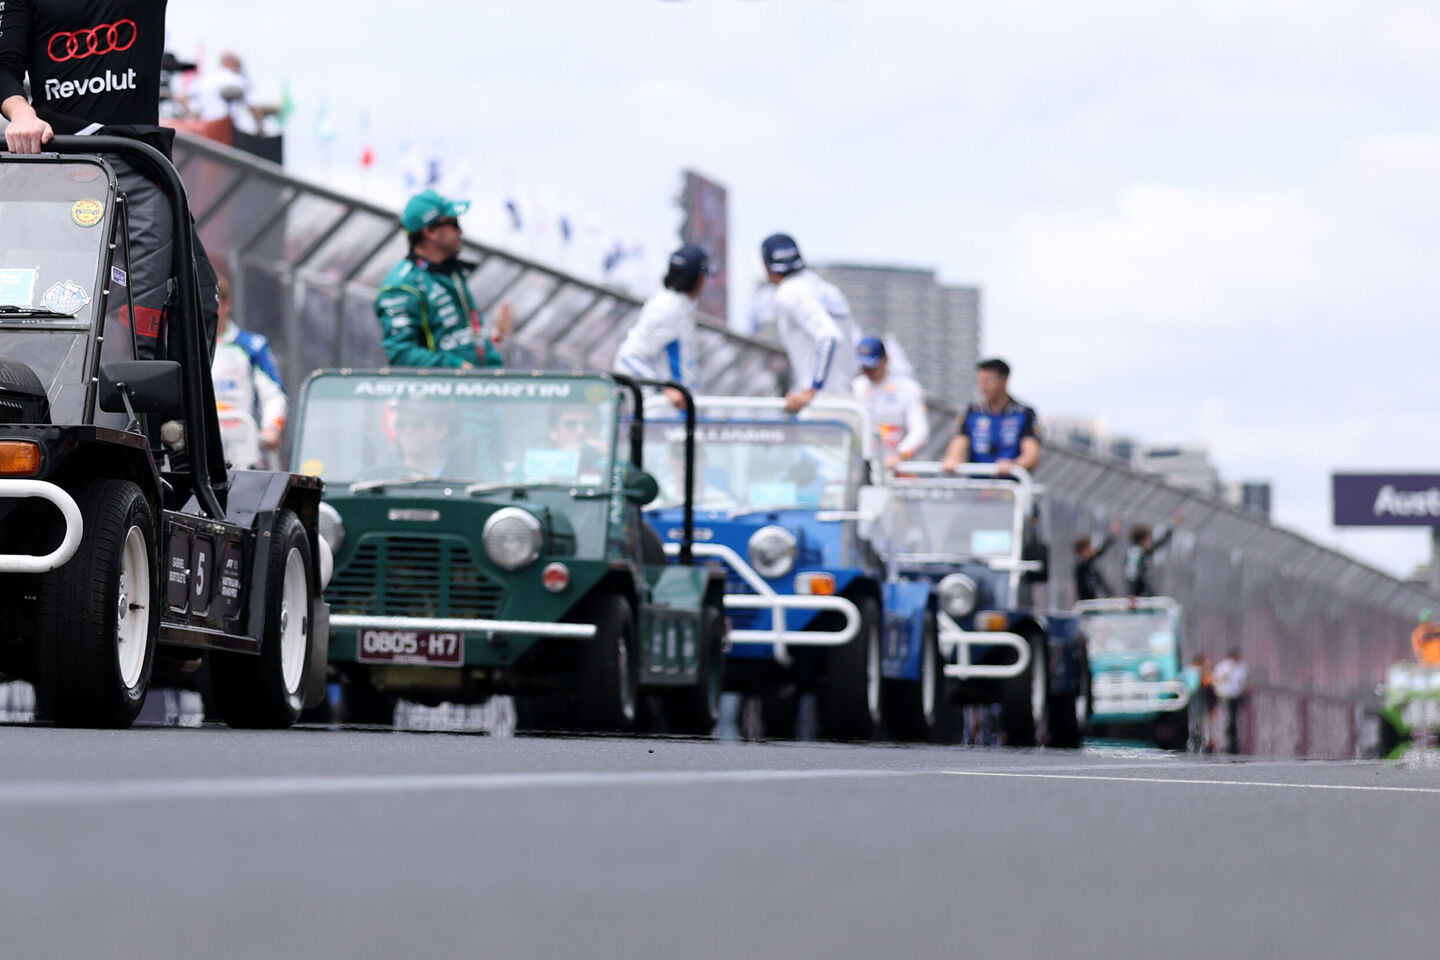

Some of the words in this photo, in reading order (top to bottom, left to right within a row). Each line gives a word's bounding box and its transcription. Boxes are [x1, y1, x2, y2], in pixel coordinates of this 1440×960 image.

[44, 68, 137, 101] Revolut
[354, 381, 452, 396] ASTON
[455, 382, 570, 397] MARTIN
[195, 552, 205, 596] 5
